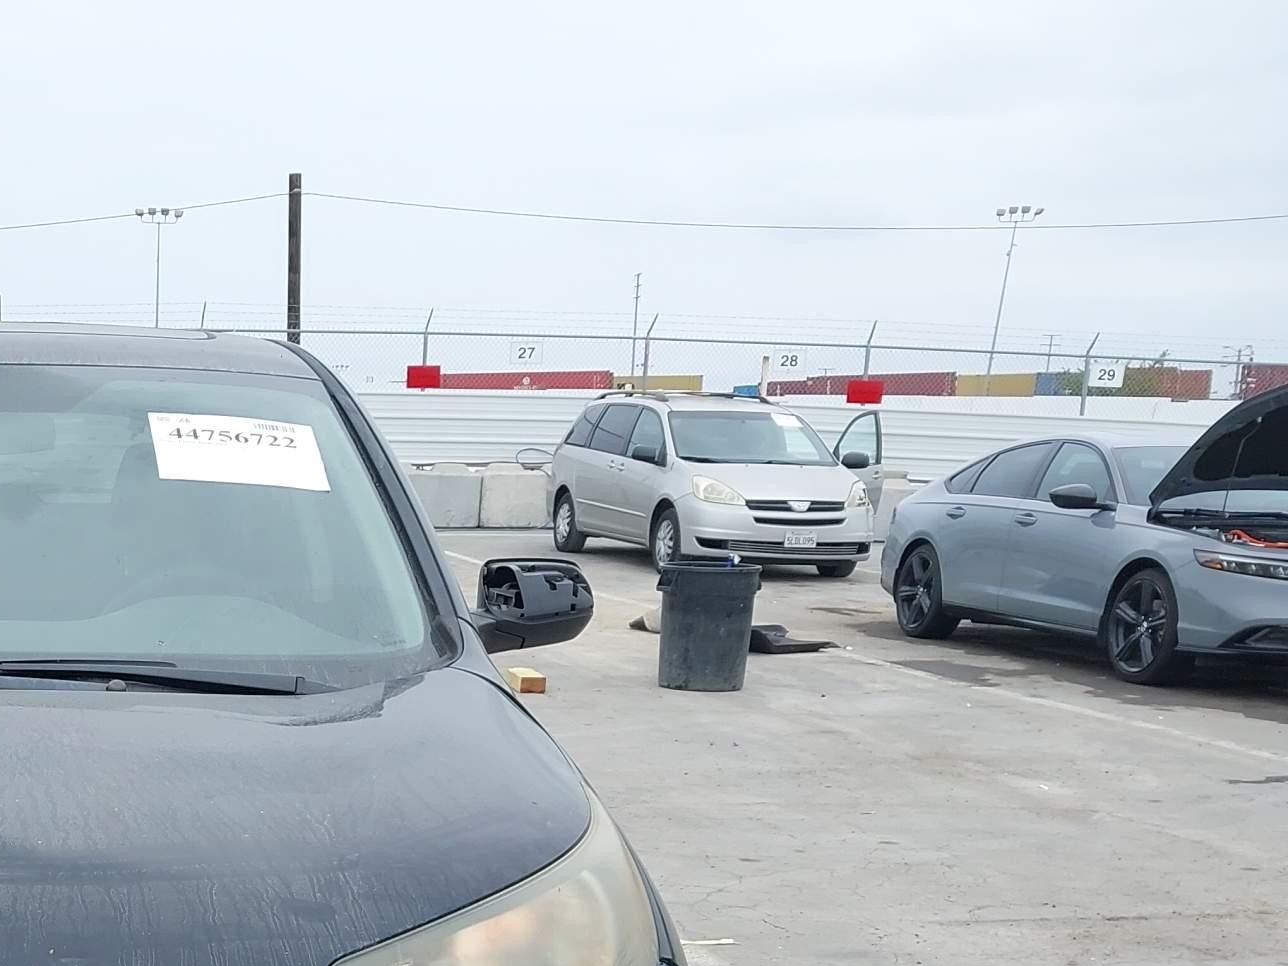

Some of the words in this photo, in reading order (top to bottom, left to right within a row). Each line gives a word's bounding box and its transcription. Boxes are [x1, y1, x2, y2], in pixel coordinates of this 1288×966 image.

[518, 346, 536, 360] 27
[780, 354, 799, 367] 28
[1097, 368, 1116, 381] 29
[168, 427, 297, 449] 44756722
